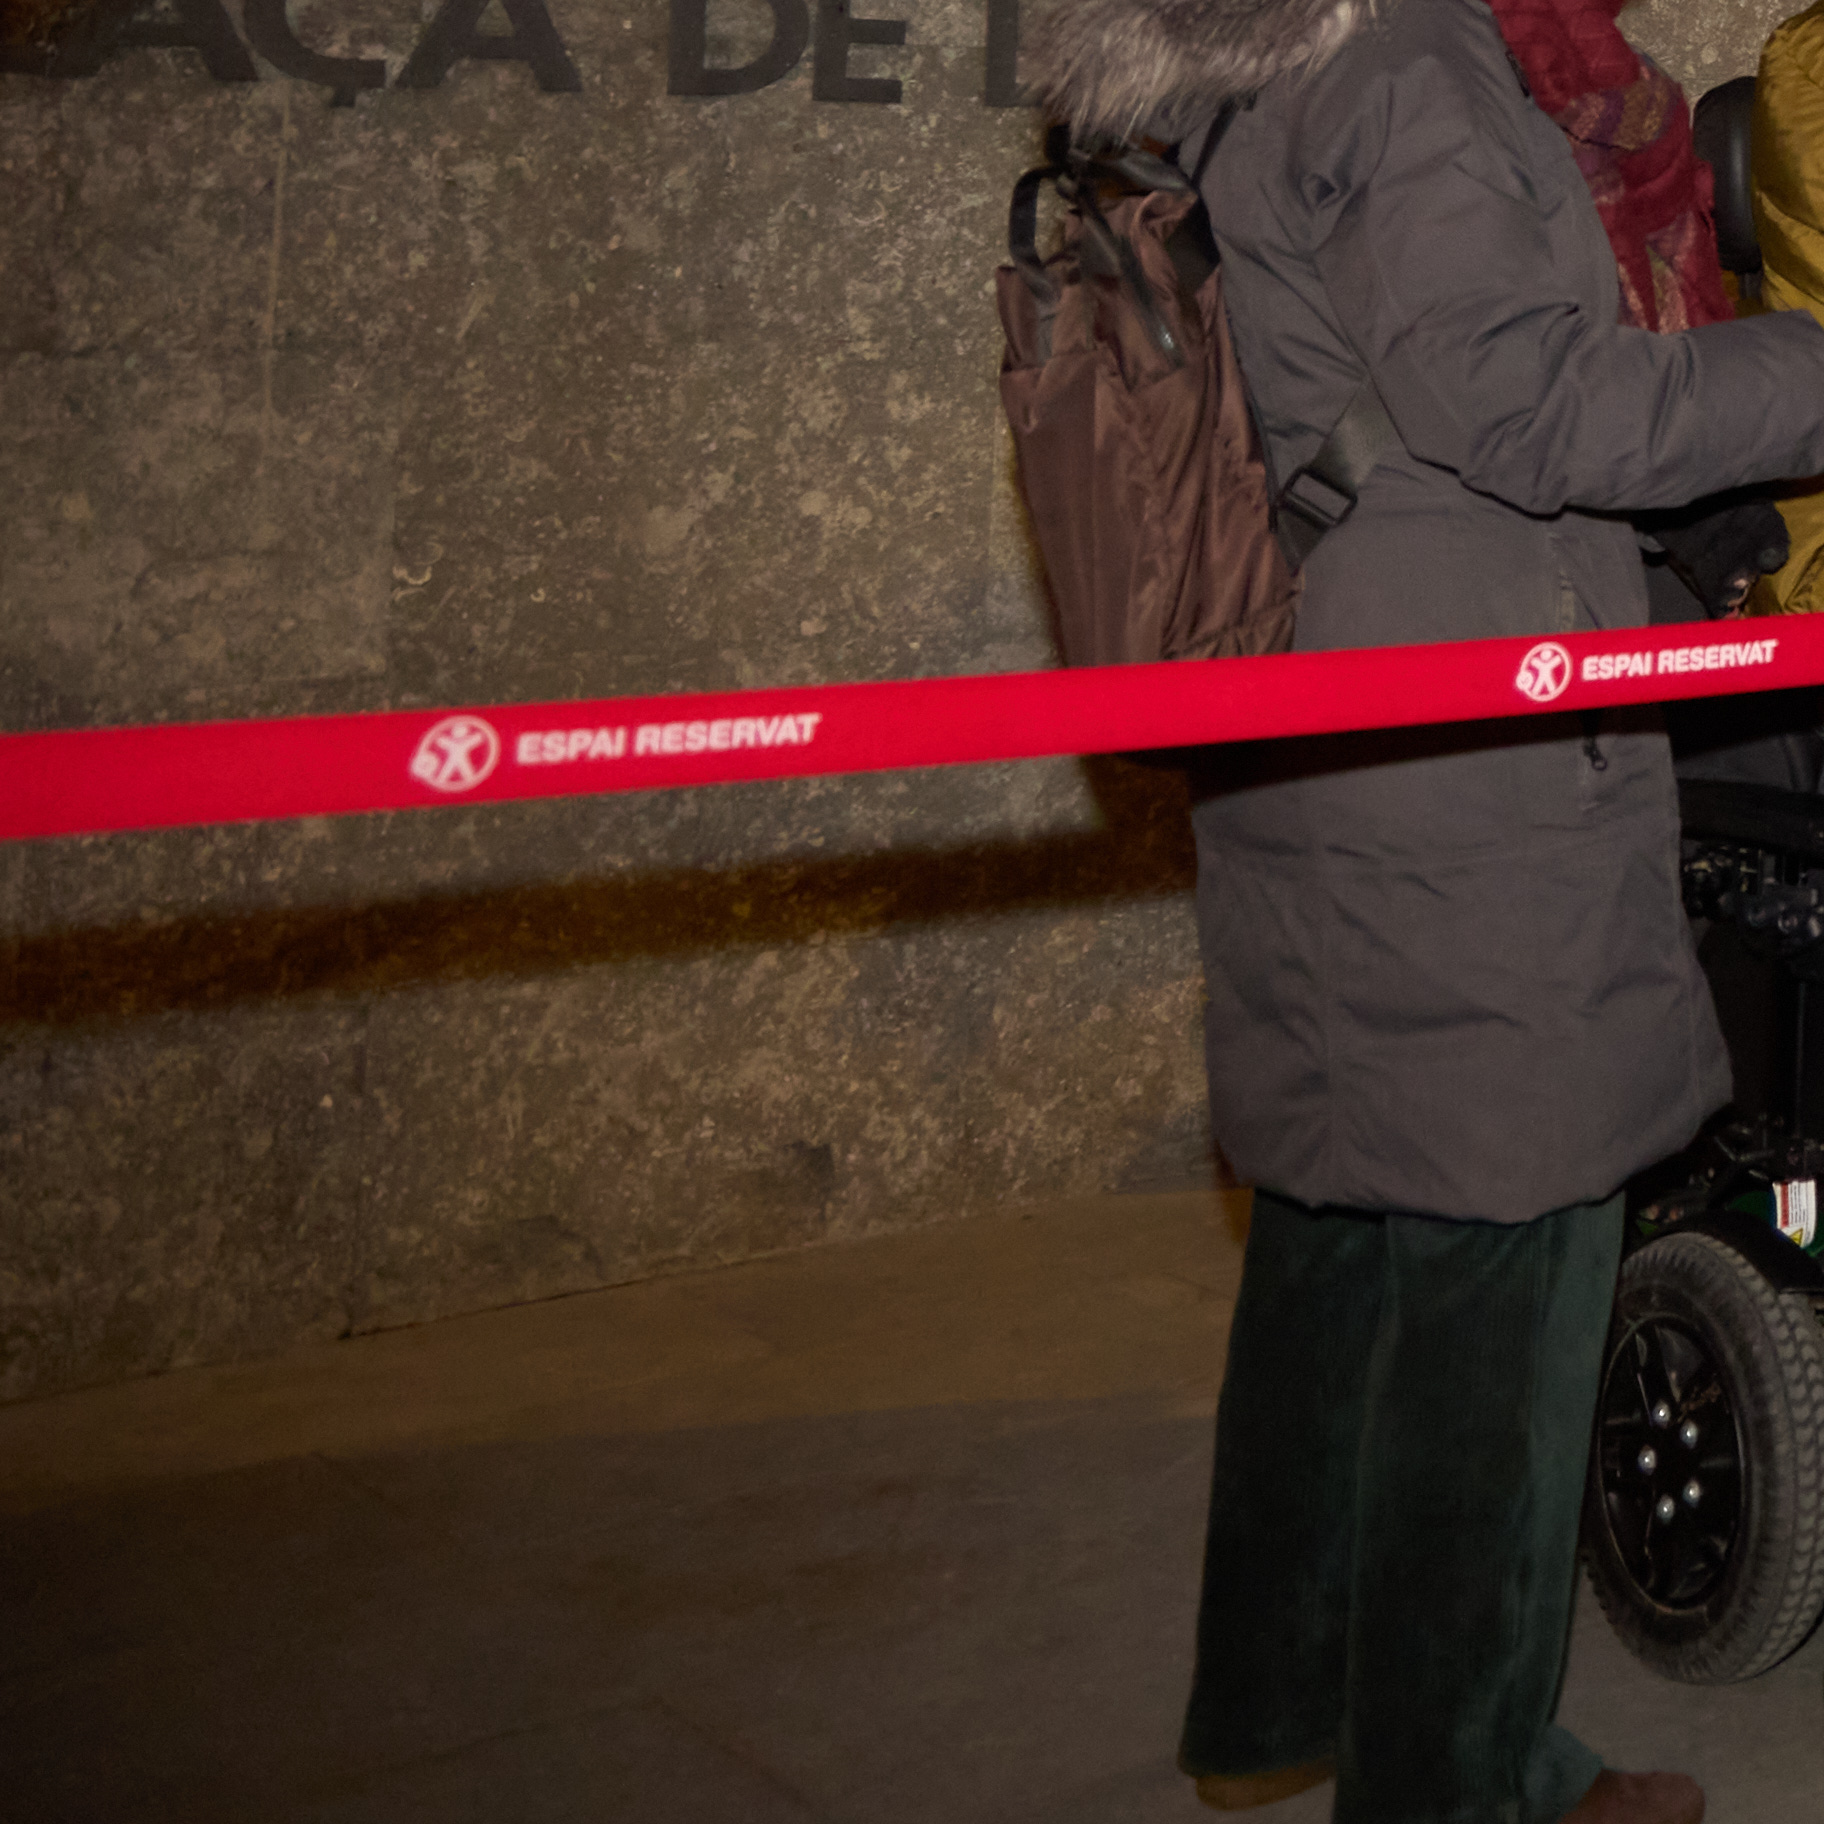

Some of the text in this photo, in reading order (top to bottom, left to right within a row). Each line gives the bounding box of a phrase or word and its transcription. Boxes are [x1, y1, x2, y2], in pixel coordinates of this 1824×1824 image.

[1581, 639, 1779, 681] ESPAI RESERVAT
[515, 713, 822, 764] ESPAI RESERVAT
